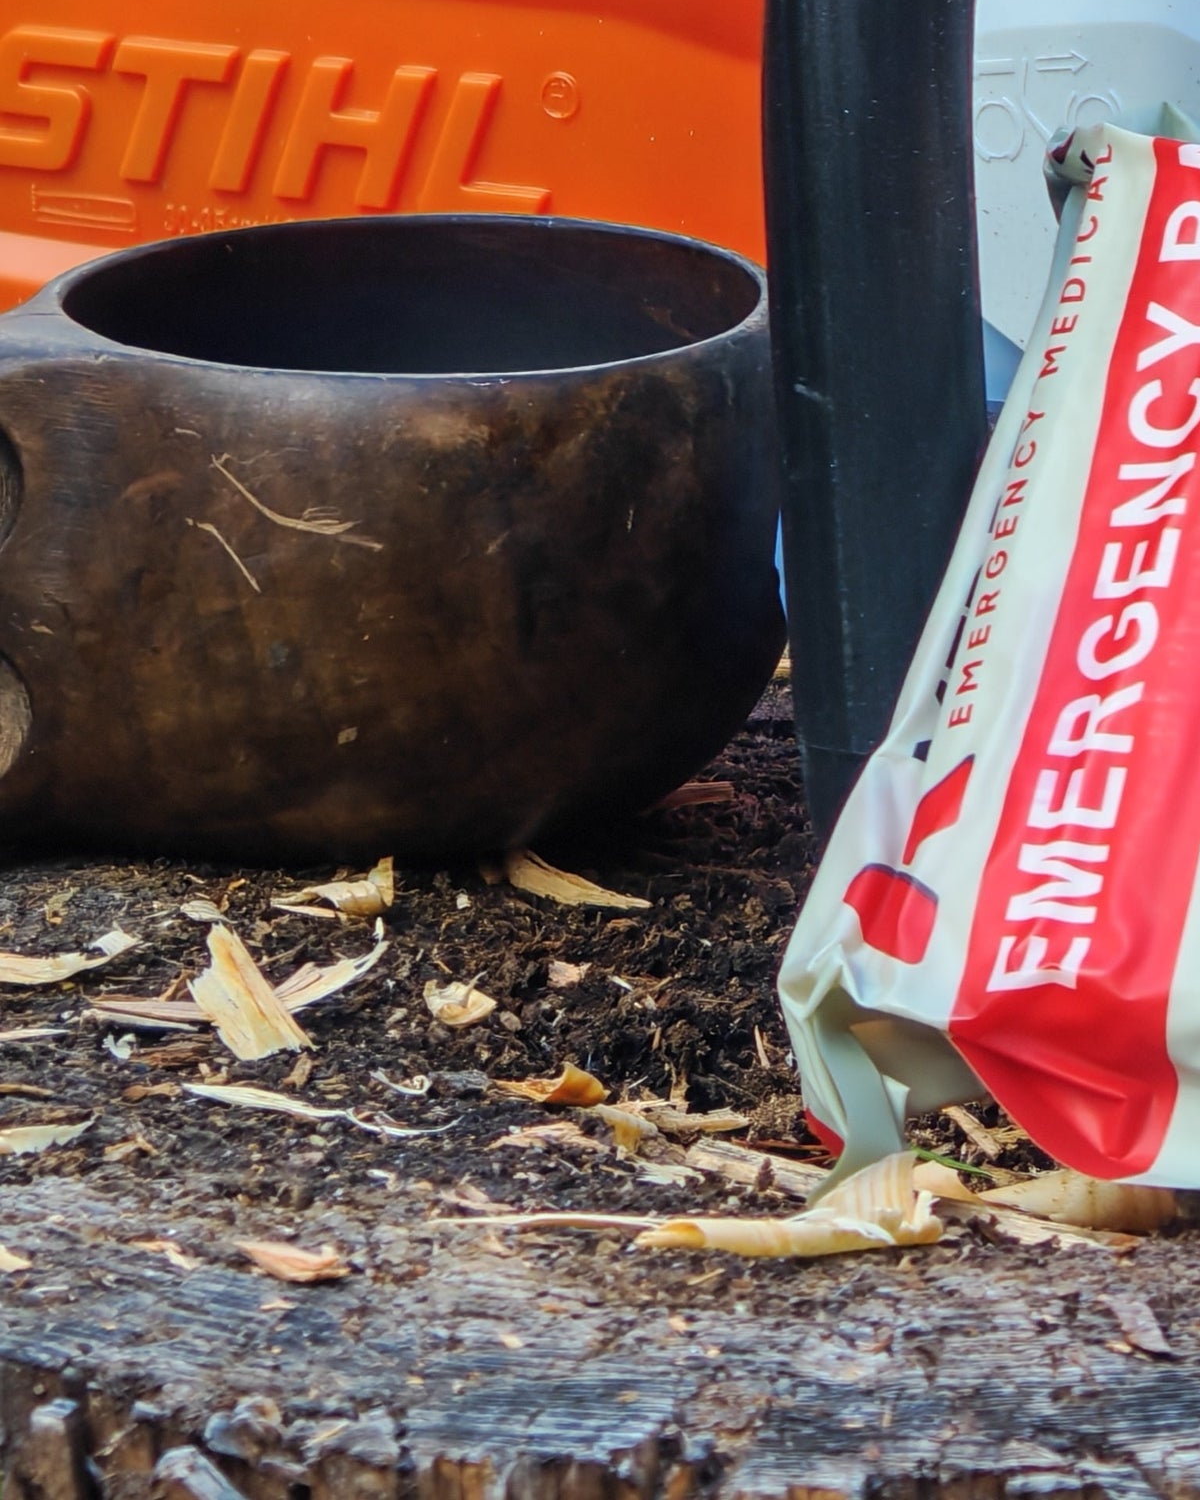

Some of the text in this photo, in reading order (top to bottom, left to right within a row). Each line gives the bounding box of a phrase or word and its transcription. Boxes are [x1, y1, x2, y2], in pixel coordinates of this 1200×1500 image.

[0, 23, 551, 216] STIHL
[947, 409, 1046, 730] EMERGENCY
[1038, 143, 1114, 380] MEDICAL
